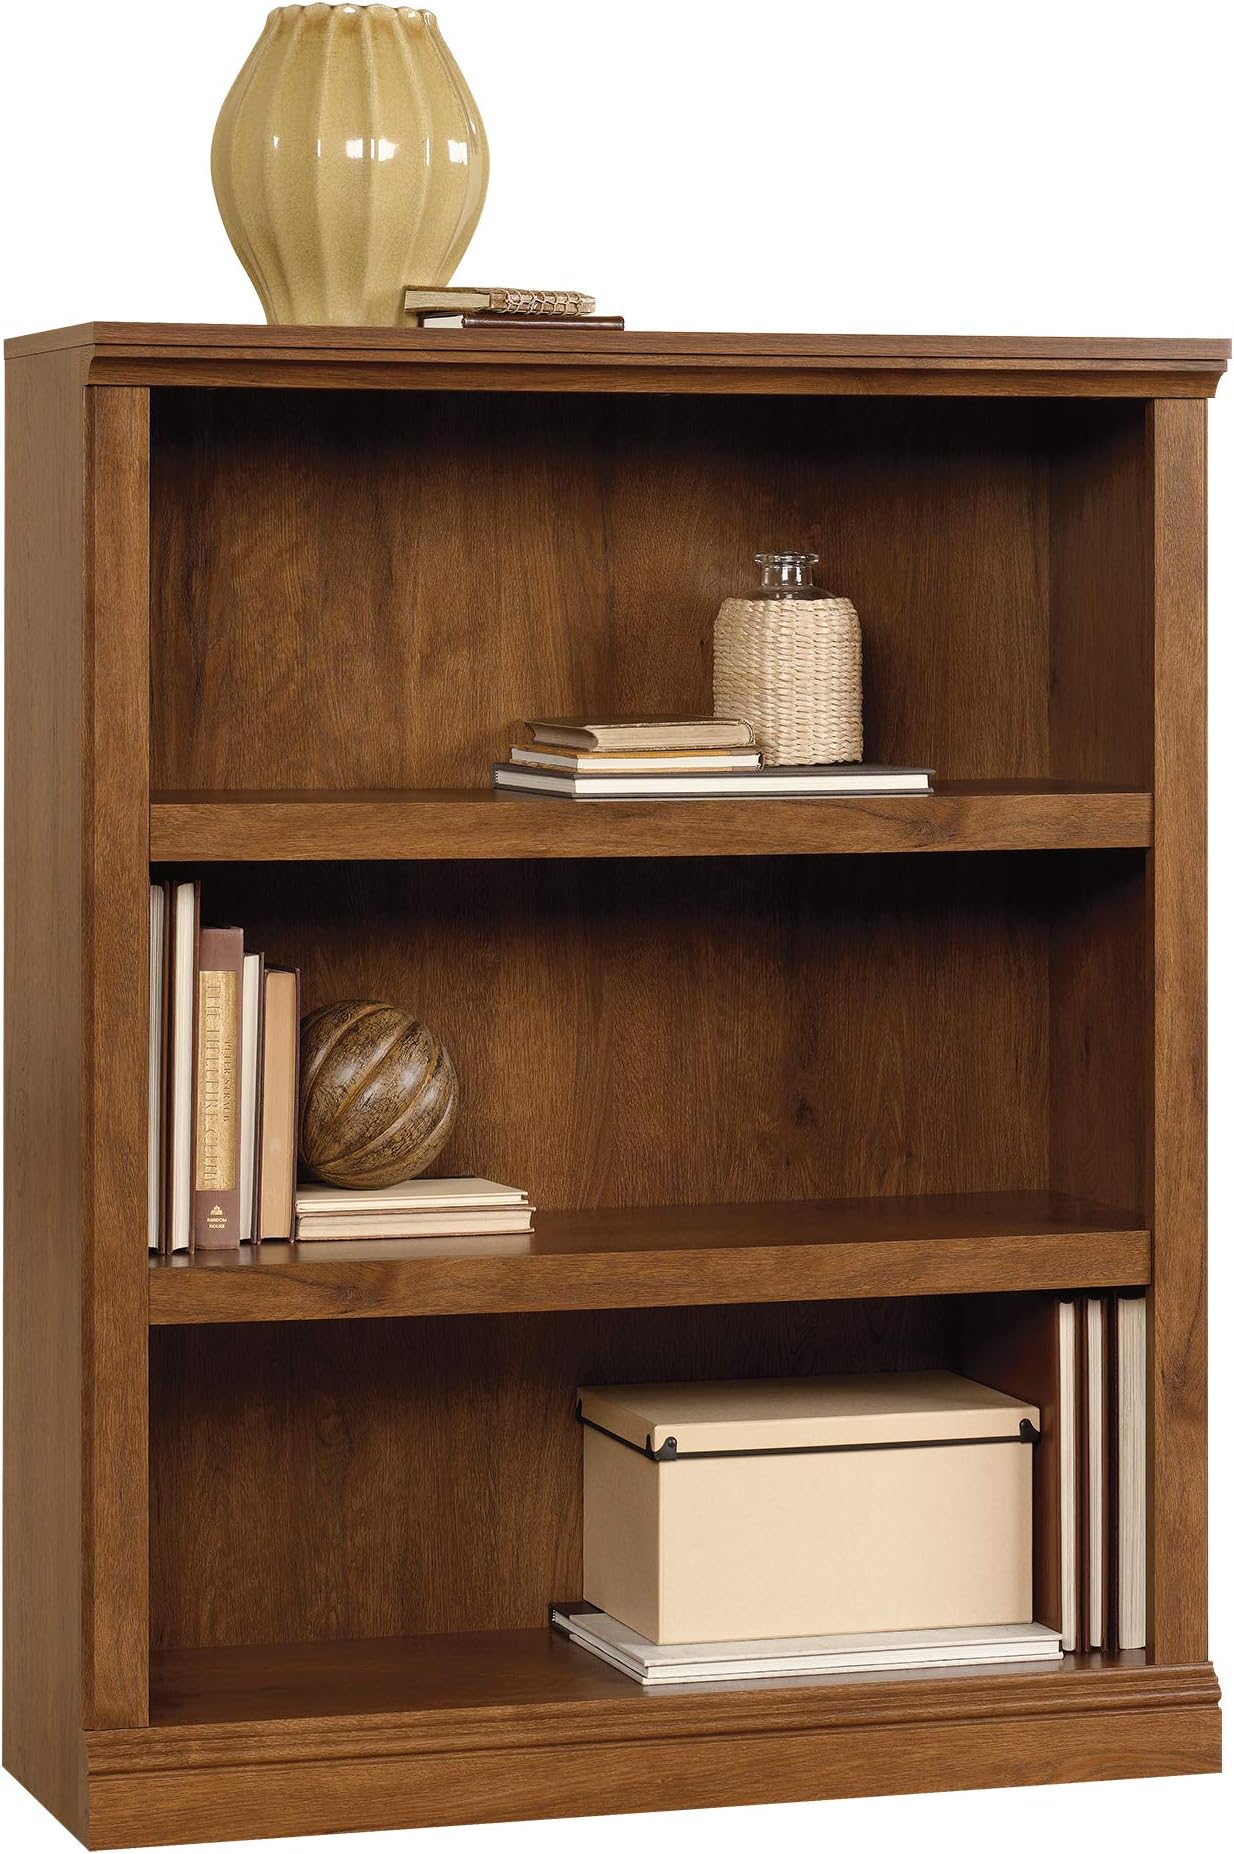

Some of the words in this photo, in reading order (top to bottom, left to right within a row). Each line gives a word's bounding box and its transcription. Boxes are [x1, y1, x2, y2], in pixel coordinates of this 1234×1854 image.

[206, 985, 220, 1022] THE
[205, 1030, 220, 1121] HELLFIRE
[224, 1041, 233, 1075] PETER
[223, 1079, 232, 1123] STRAUB
[203, 1129, 218, 1182] CLUB
